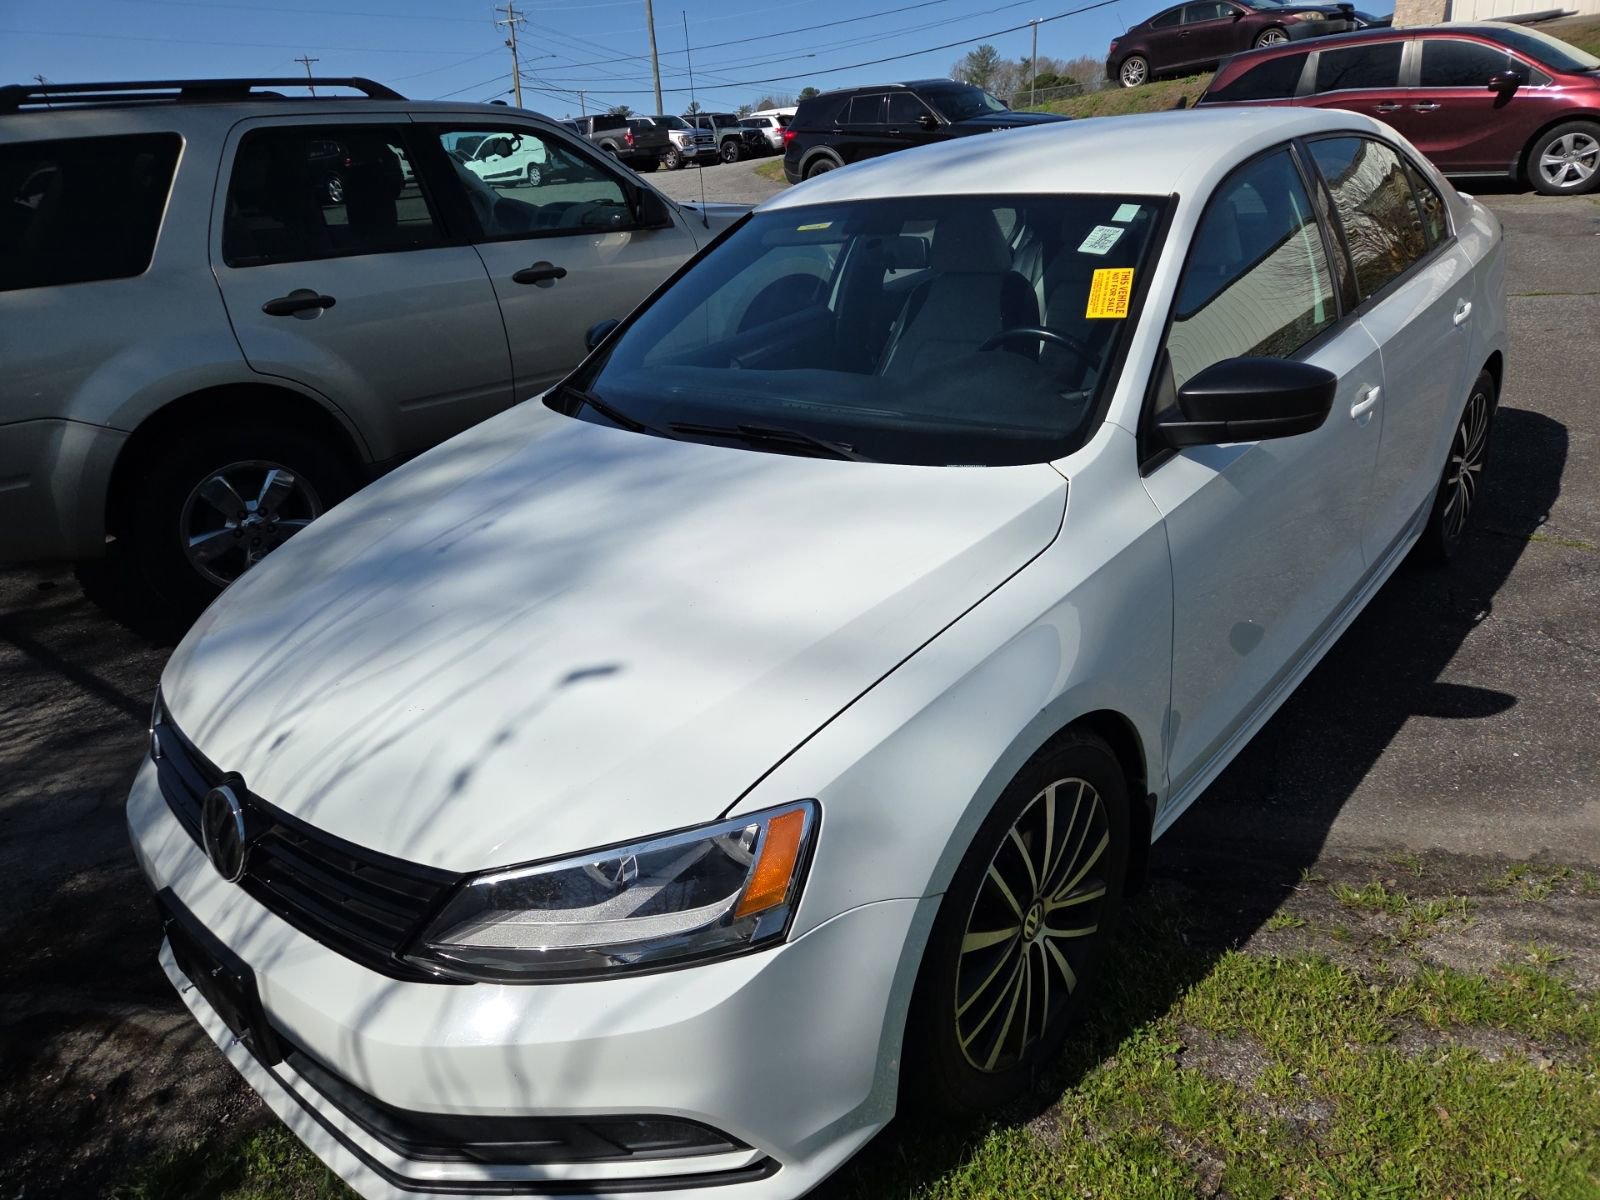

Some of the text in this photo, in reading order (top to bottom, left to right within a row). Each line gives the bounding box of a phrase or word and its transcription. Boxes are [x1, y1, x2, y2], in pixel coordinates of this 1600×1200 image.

[1106, 272, 1120, 313] NOT FOR SALE
[1115, 271, 1131, 314] THIS VEHICLE
